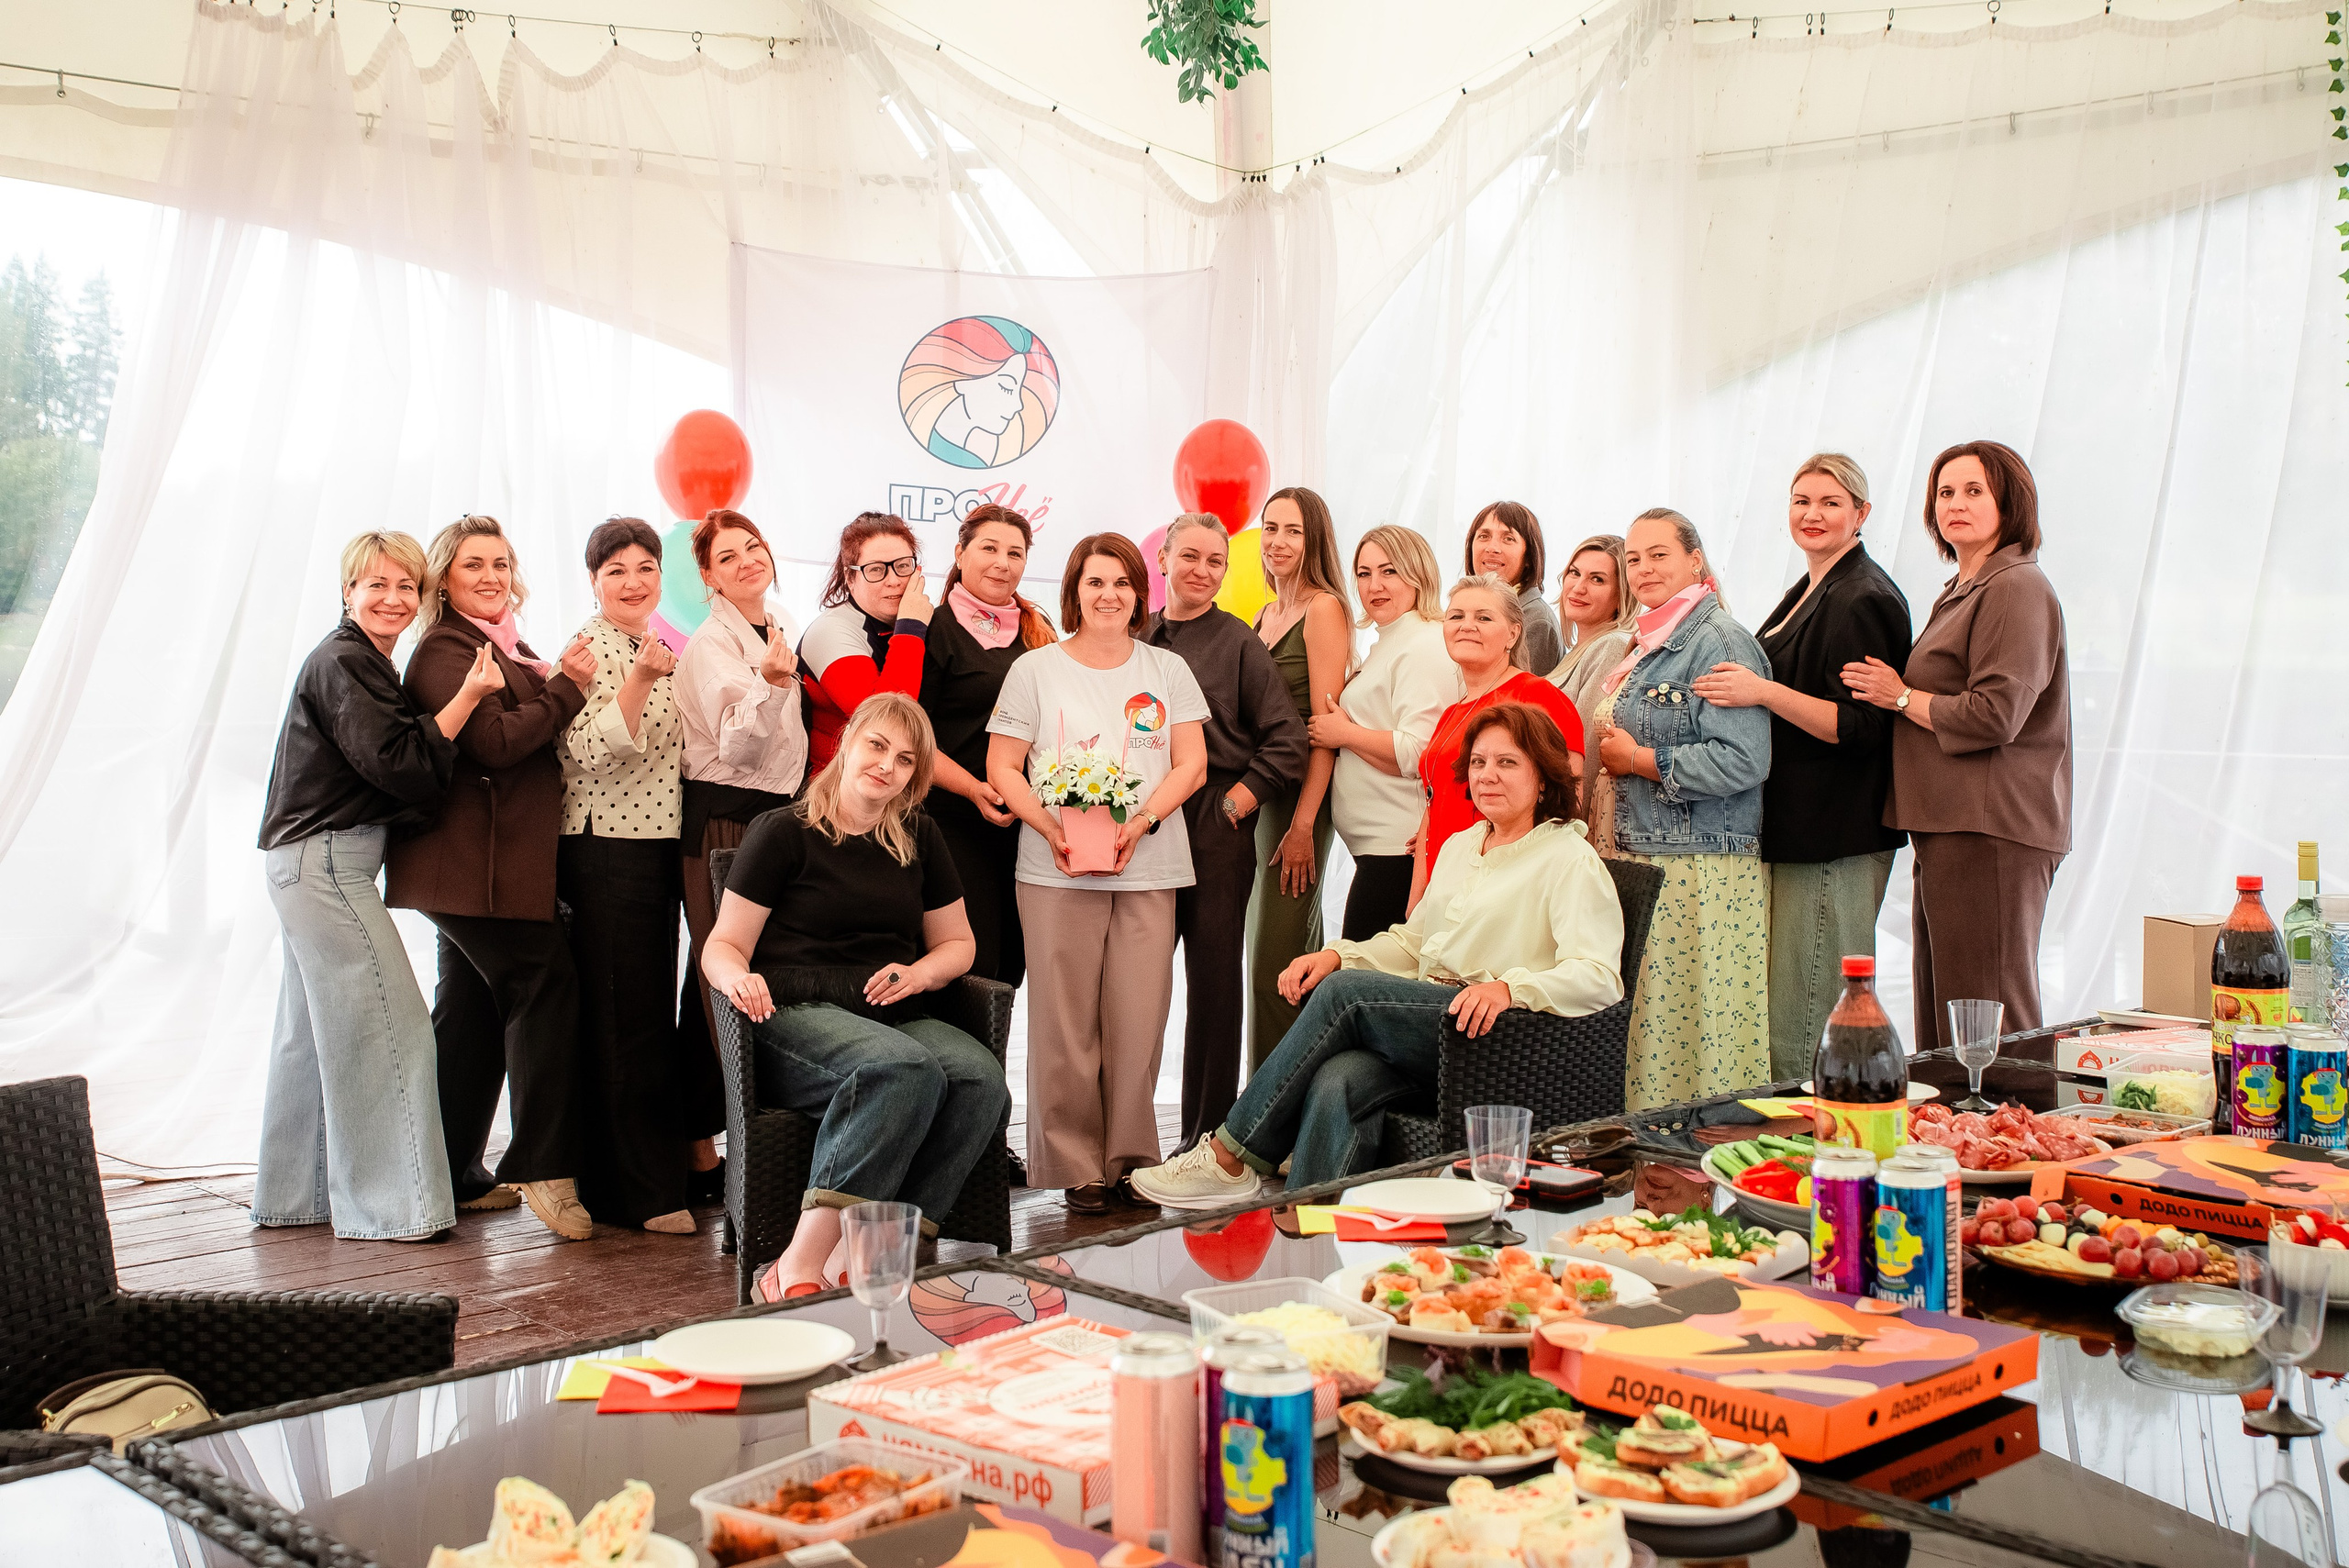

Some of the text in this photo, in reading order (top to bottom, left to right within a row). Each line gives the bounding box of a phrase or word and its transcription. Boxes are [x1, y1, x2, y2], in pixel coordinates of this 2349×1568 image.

[2299, 1133, 2347, 1149] ЛУННЫ
[2140, 1198, 2265, 1230] ДОДО ПИЦЦА
[1608, 1375, 1789, 1438] ДОДО ПИЦЦА
[1890, 1373, 1981, 1421] ДОДО ПИЦЦА
